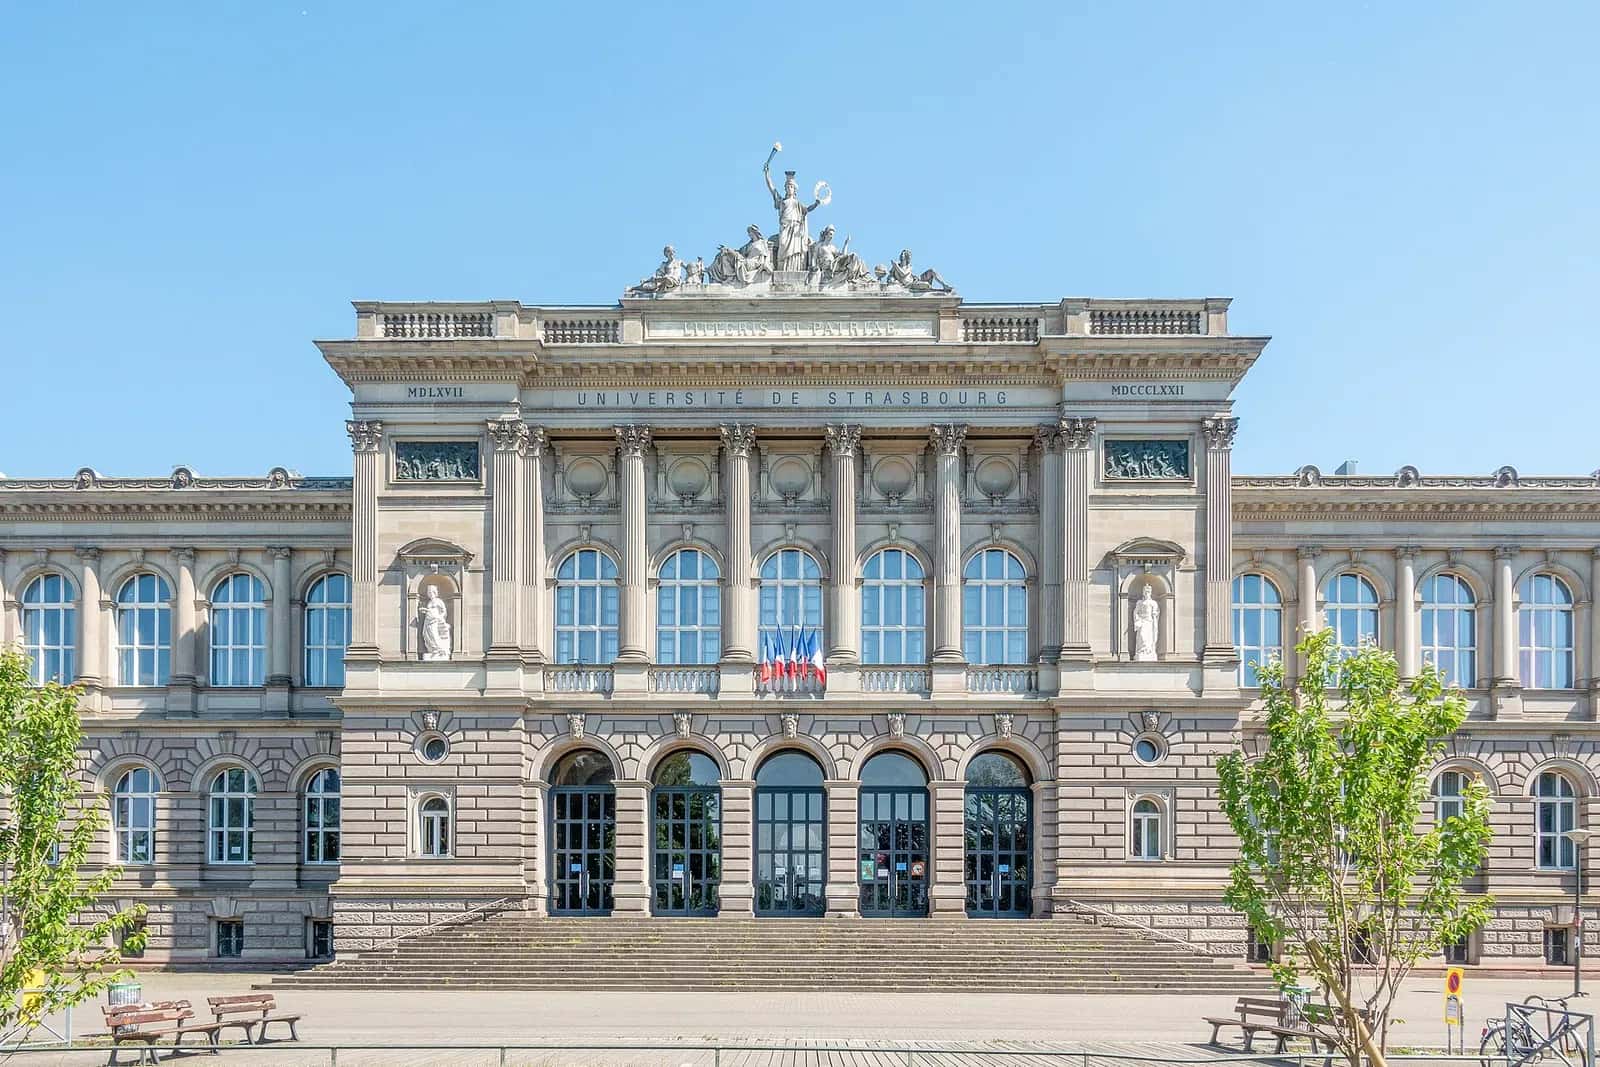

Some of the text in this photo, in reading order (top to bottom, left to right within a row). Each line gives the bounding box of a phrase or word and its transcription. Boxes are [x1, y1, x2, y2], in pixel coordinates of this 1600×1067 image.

[408, 387, 463, 398] MDLXVII
[1111, 385, 1184, 396] MDCCCLXXII
[577, 389, 1007, 406] UNIVERSITÉ DE STRASBOURG
